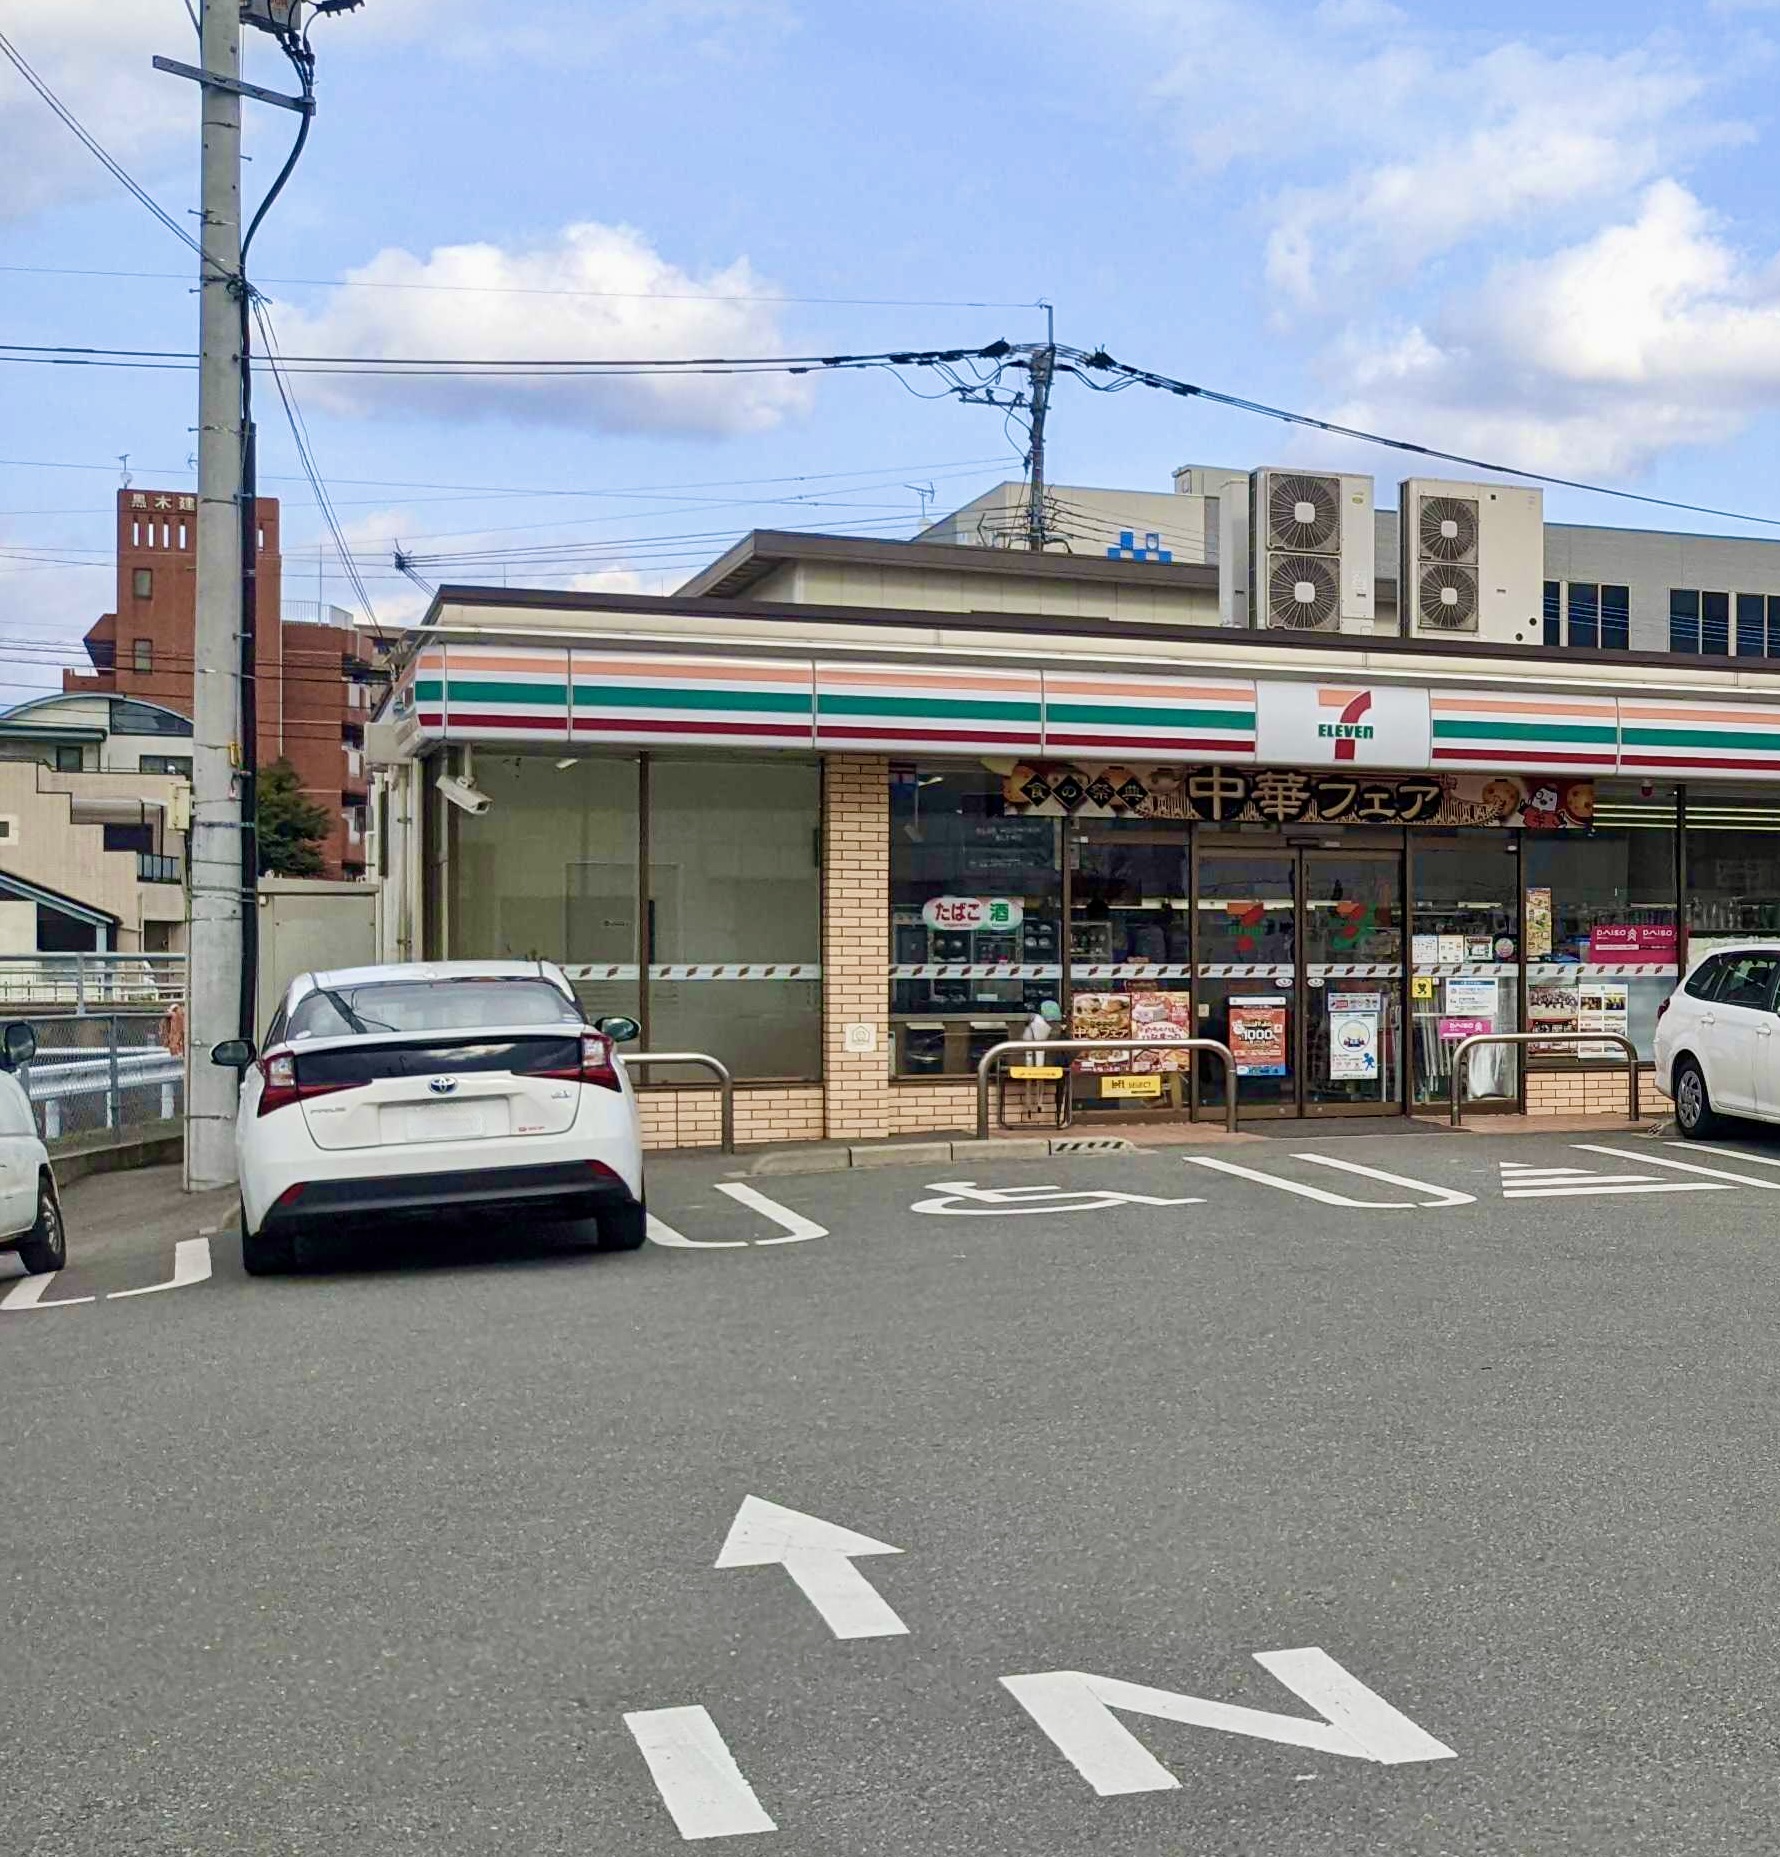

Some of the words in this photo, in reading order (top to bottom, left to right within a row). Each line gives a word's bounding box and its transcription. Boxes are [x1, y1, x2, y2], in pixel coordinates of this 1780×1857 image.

[1318, 689, 1372, 760] 7
[1188, 765, 1442, 822] 中華フェア
[934, 903, 981, 922] たばこ
[989, 903, 1010, 922] 酒
[1596, 929, 1626, 937] DAISO
[1642, 929, 1673, 937] DAISO
[622, 1646, 1457, 1841] IN
